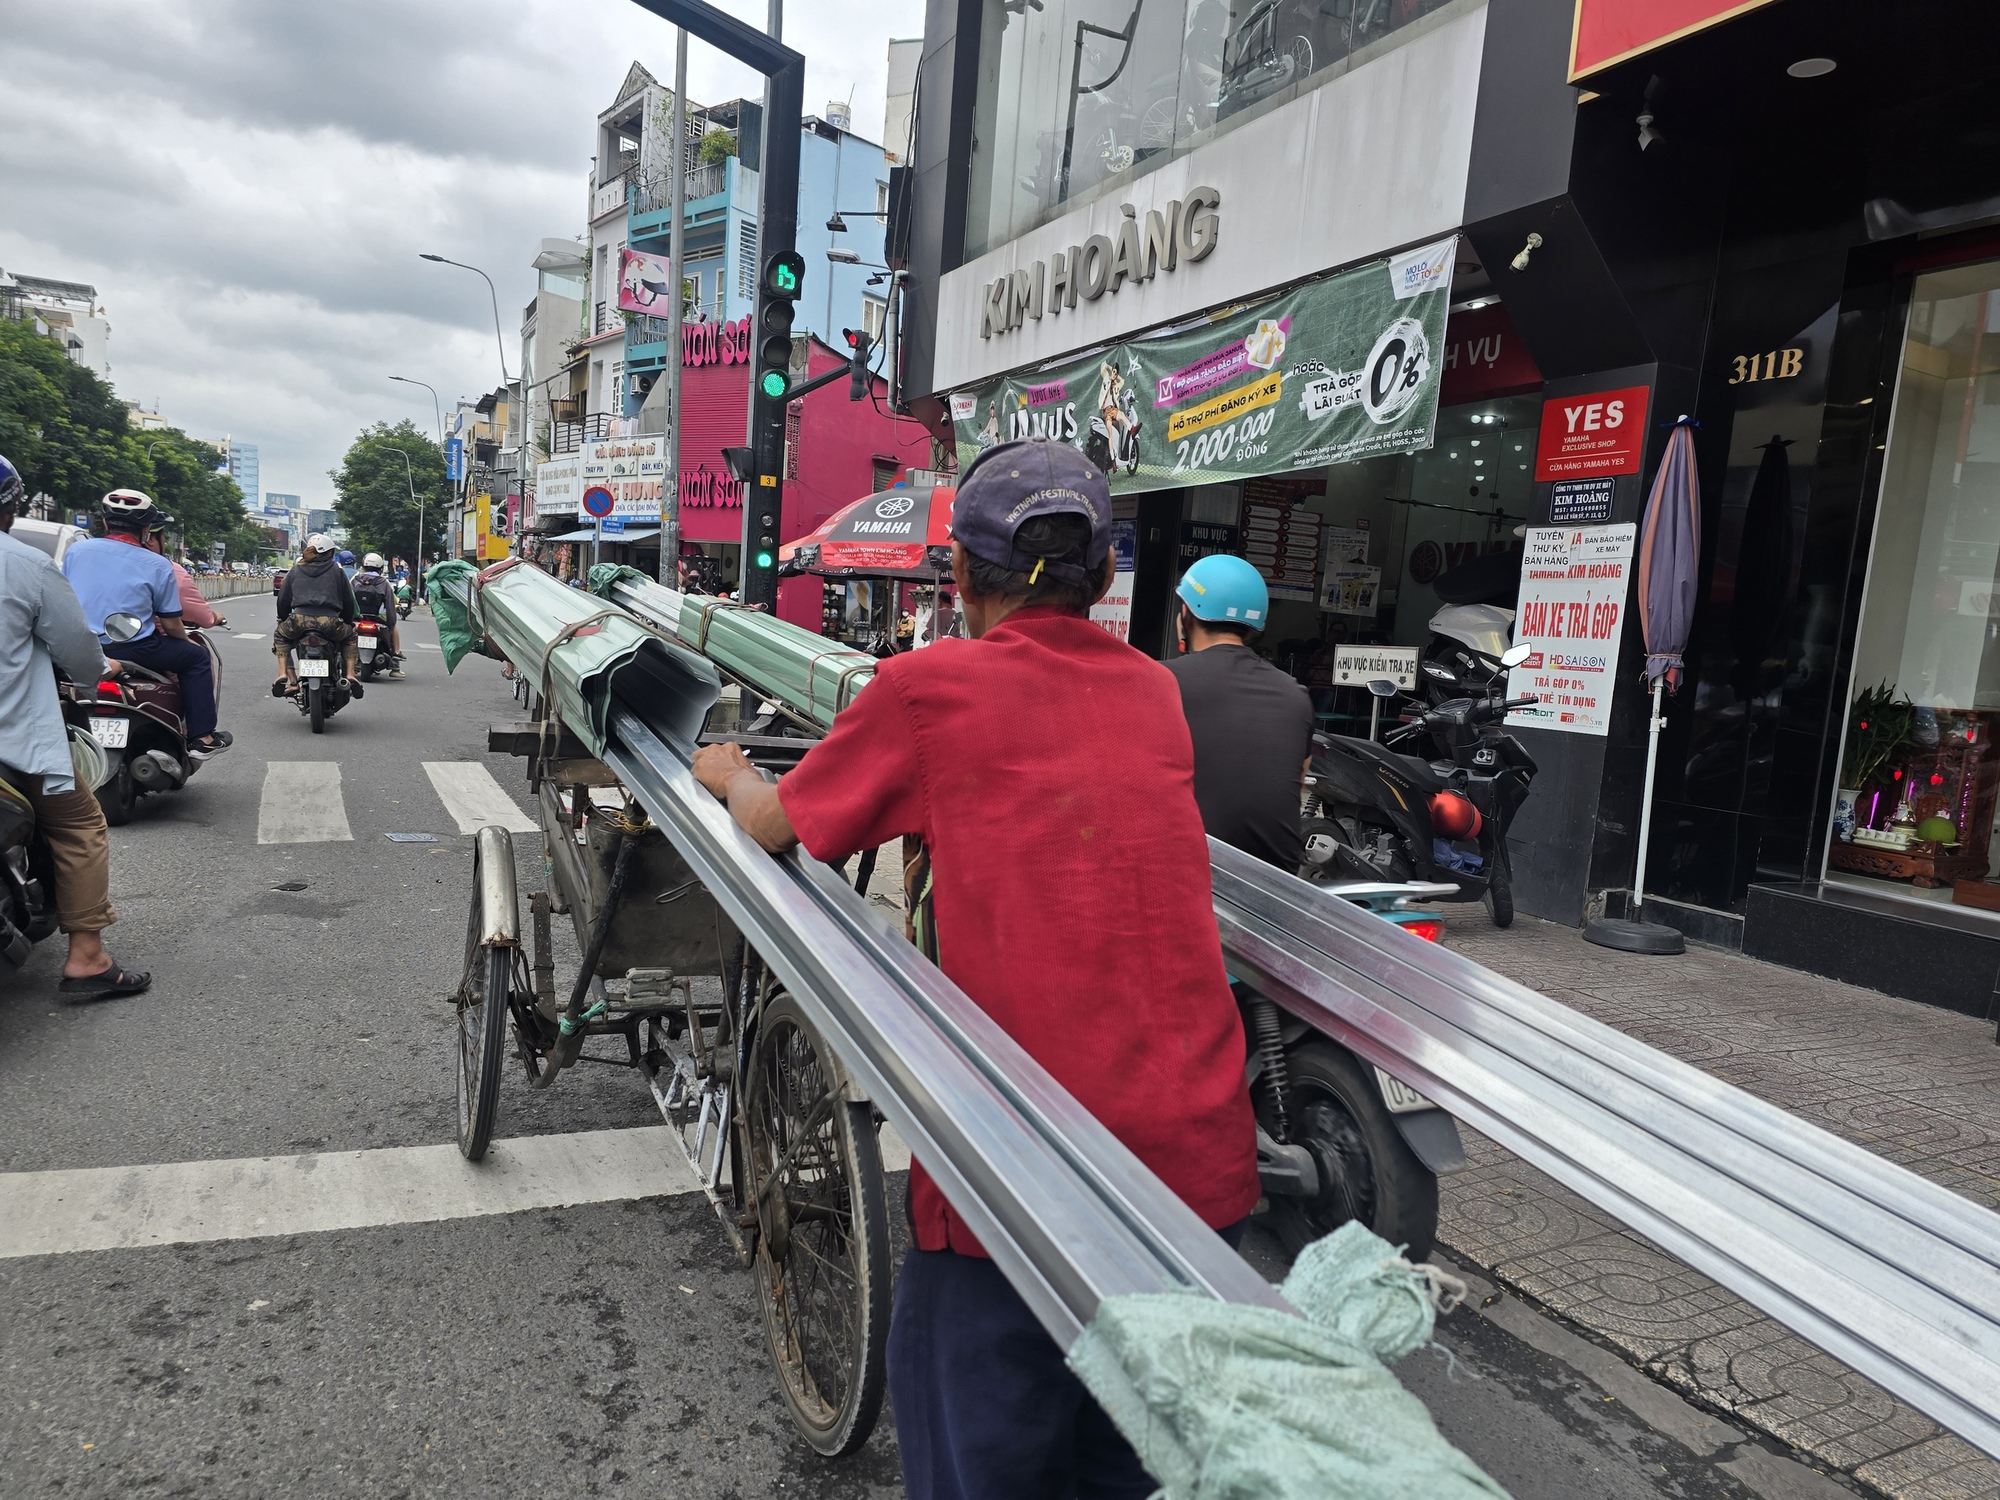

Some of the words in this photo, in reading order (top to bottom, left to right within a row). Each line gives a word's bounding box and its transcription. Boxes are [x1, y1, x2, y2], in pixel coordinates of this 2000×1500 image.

[980, 260, 1044, 339] KIM
[1048, 185, 1220, 314] HOÀNG
[682, 313, 719, 366] NÓN
[722, 313, 752, 365] SƠ
[1213, 354, 1224, 362] MUA
[1225, 344, 1243, 356] JANUS
[1468, 334, 1502, 368] VỤ
[1293, 358, 1324, 376] hoặc
[1371, 338, 1422, 407] 0%
[1729, 348, 1804, 384] 311B
[1339, 373, 1363, 388] GÓP
[1174, 415, 1184, 431] HỖ
[1187, 412, 1203, 425] TRỢ
[1205, 404, 1219, 419] PHÍ
[1221, 394, 1246, 413] ĐĂNG
[1248, 388, 1261, 402] KÝ
[1262, 384, 1276, 396] XE
[1314, 395, 1332, 410] LÃI
[1564, 400, 1624, 433] YES
[1562, 442, 1596, 452] EXCLUSIVE
[1598, 440, 1616, 448] SHOP
[1564, 435, 1589, 443] YAMAHA
[1236, 441, 1268, 461] ĐỒNG
[1550, 462, 1562, 471] CỬA
[1564, 460, 1582, 470] HÀNG
[1583, 460, 1610, 468] YAMAHA
[681, 464, 712, 507] NÓN
[1555, 495, 1573, 505] KIM
[1575, 491, 1609, 503] HOÀNG
[1006, 492, 1040, 523] VIETNAM
[1040, 489, 1081, 500] FESTIVAL
[1081, 494, 1098, 524] TRAVEL
[852, 521, 912, 534] YAMAHA
[1192, 527, 1209, 539] KHU
[1211, 528, 1227, 543] VỰC
[1180, 542, 1198, 556] TIẾP
[1533, 544, 1551, 552] THƯ
[1552, 542, 1564, 552] KÝ
[1544, 555, 1568, 565] HÀNG
[1567, 564, 1586, 578] KIM
[1588, 561, 1622, 578] HOÀNG
[1522, 594, 1547, 637] BÁN
[1548, 603, 1565, 638] XE
[1567, 590, 1590, 638] TRẢ
[1592, 595, 1618, 639] GÓP
[1338, 657, 1352, 670] KHU
[1354, 655, 1367, 673] VỰC
[1369, 653, 1387, 672] KIỂM
[1389, 659, 1402, 673] TRA
[1405, 660, 1414, 673] XE
[1550, 654, 1563, 664] HD
[1565, 655, 1606, 667] SAISON
[1535, 675, 1549, 687] TRẢ
[1553, 677, 1569, 688] GÓP
[1572, 680, 1585, 690] 0%
[1540, 692, 1554, 703] THẺ
[1558, 693, 1571, 705] TÍN
[1573, 696, 1596, 708] DỤNG
[92, 720, 121, 732] 9-F2
